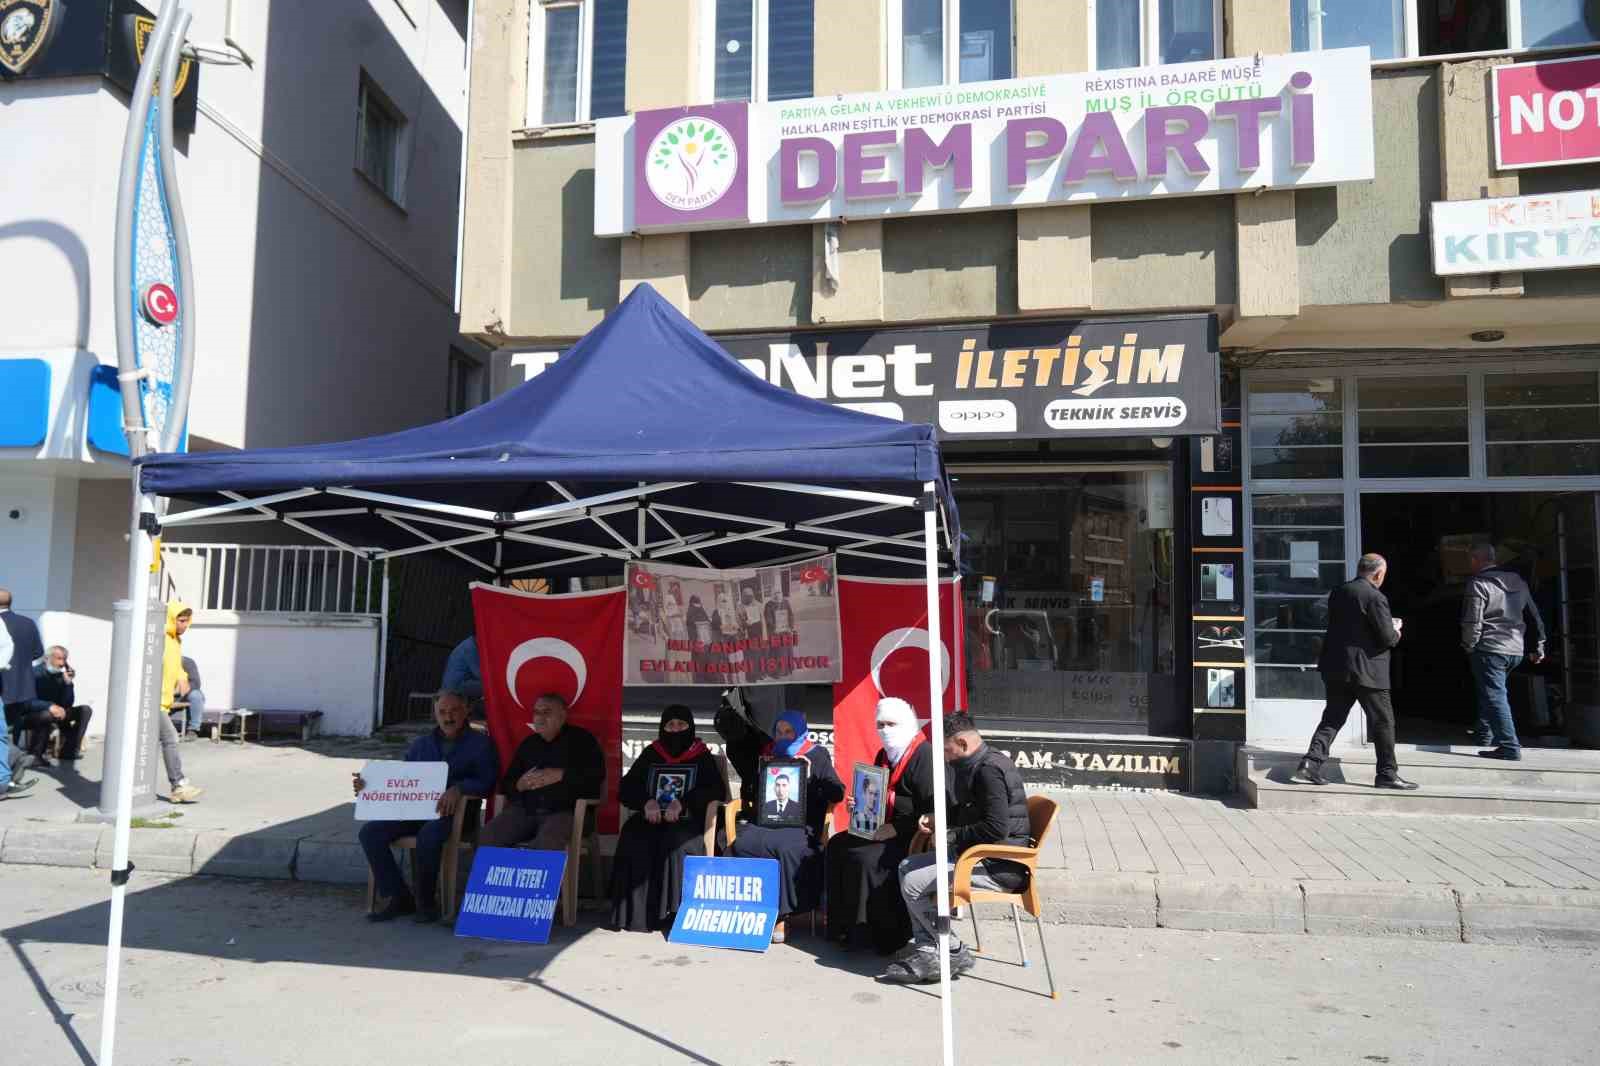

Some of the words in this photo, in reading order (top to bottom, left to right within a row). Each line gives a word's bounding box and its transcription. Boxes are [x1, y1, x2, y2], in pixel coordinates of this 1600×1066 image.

[831, 101, 871, 117] GELAN
[1086, 94, 1132, 113] MUŞ
[1140, 89, 1159, 108] İL
[1165, 84, 1263, 106] ÖRGÜTÜ
[781, 121, 850, 137] HALKLARIN
[852, 116, 899, 132] EŞİTLİK
[902, 114, 919, 127] VE
[919, 106, 993, 125] DEMOKRASİ
[996, 101, 1047, 118] PARTİSİ
[781, 124, 972, 203] DEM
[1006, 70, 1316, 189] PARTİ
[955, 333, 1186, 396] İLETİŞİM
[950, 410, 1005, 420] oppo
[1050, 404, 1115, 421] TEKNİK
[1119, 402, 1182, 419] SERVİS
[1071, 752, 1181, 774] YAZILIM
[361, 790, 441, 801] NÖBETİNDEYİZ
[387, 779, 420, 788] EVLAT
[484, 866, 515, 886] ARTIK
[693, 874, 763, 902] ANNELER
[463, 893, 524, 917] YAKAMIZDAN
[523, 893, 557, 925] DÜŞÜN
[681, 903, 768, 936] DİRENİYOR
